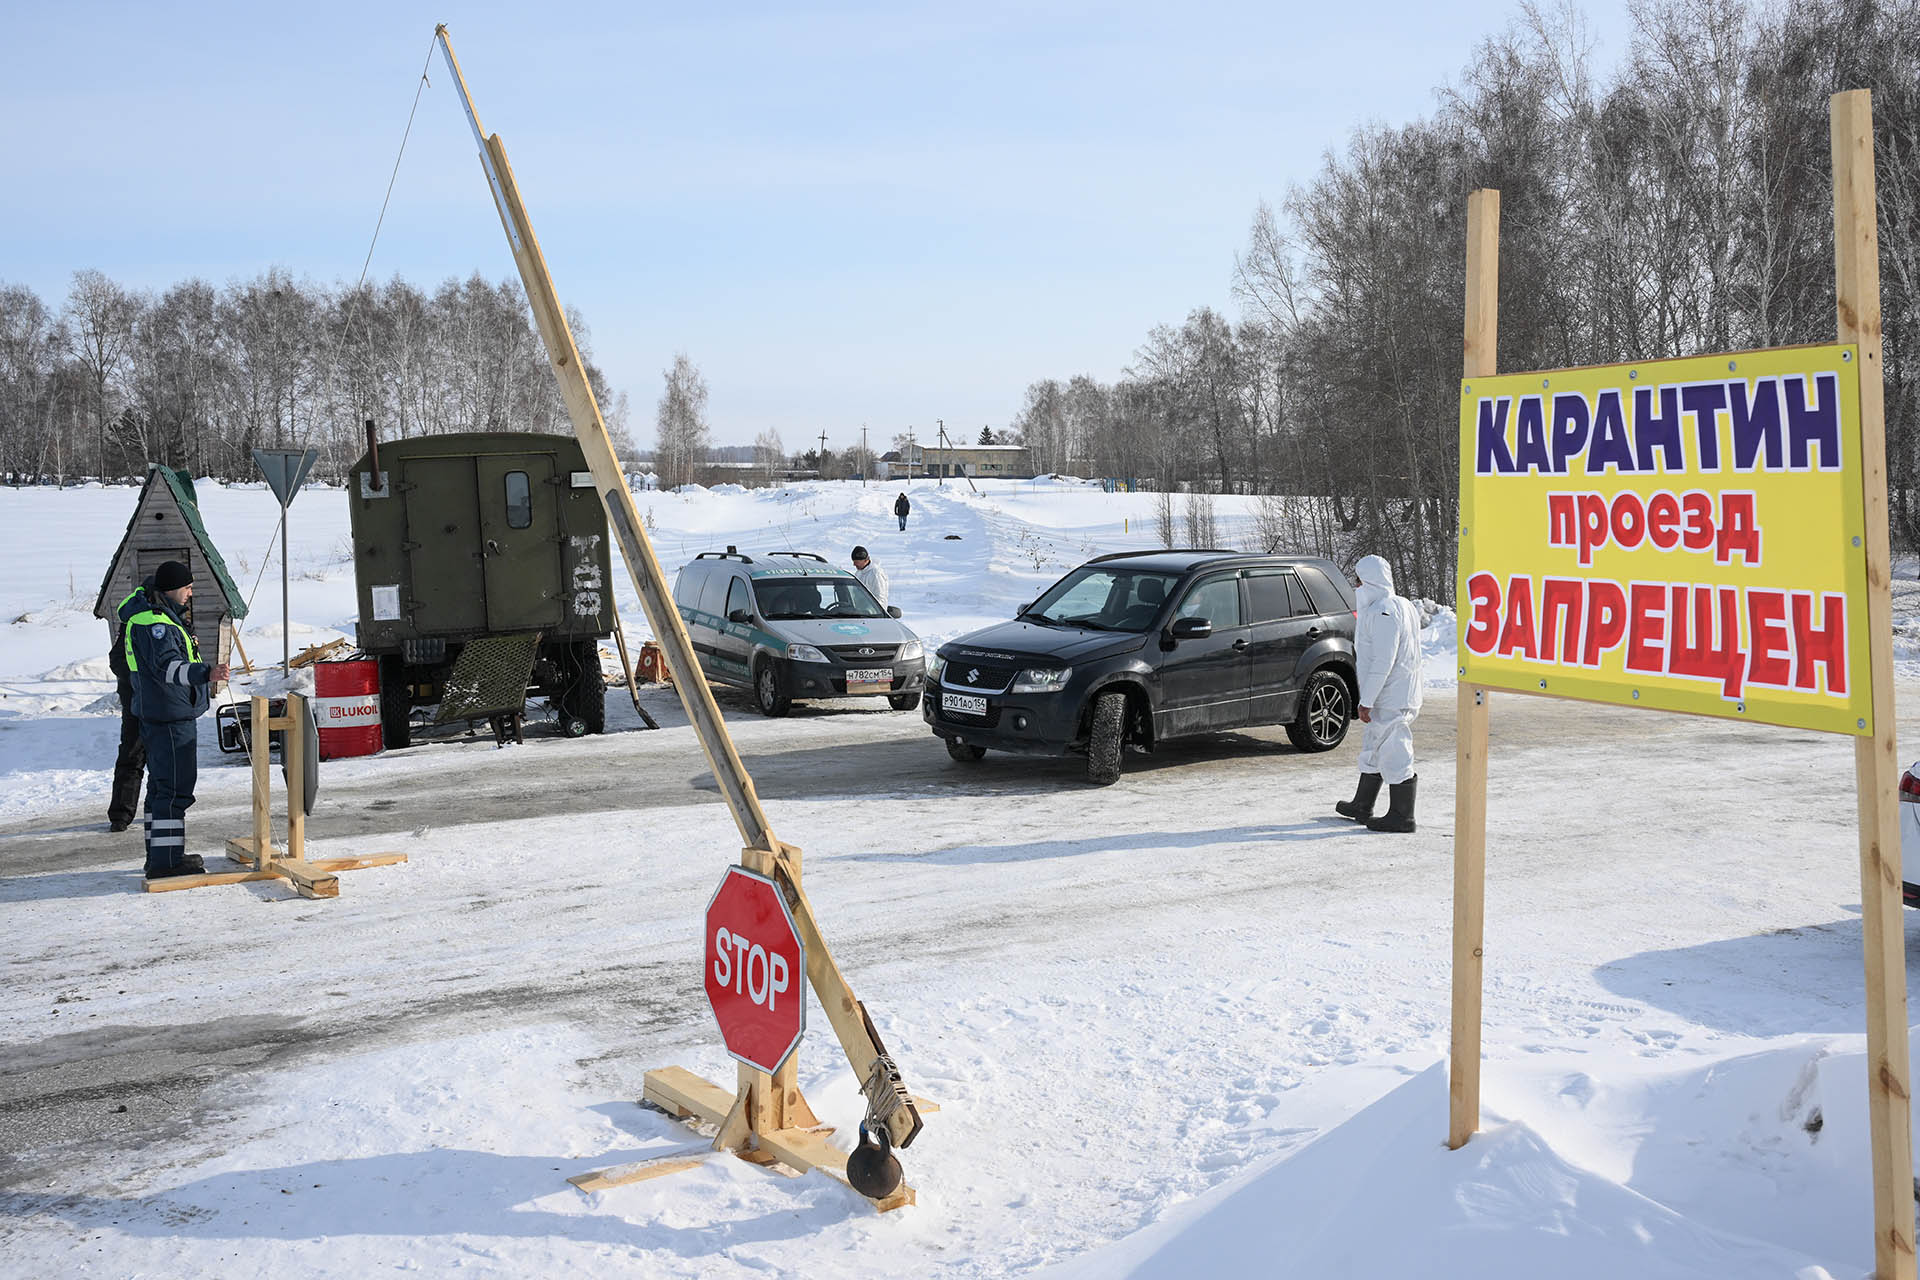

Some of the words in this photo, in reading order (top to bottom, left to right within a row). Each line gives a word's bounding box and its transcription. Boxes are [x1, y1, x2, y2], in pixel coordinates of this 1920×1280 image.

[1476, 371, 1842, 474] КАРАНТИН
[1548, 489, 1762, 567] проезд
[1464, 570, 1850, 702] ЗАПРЕЩЕН
[342, 705, 378, 717] LUKOIL
[714, 927, 789, 1012] STOP
